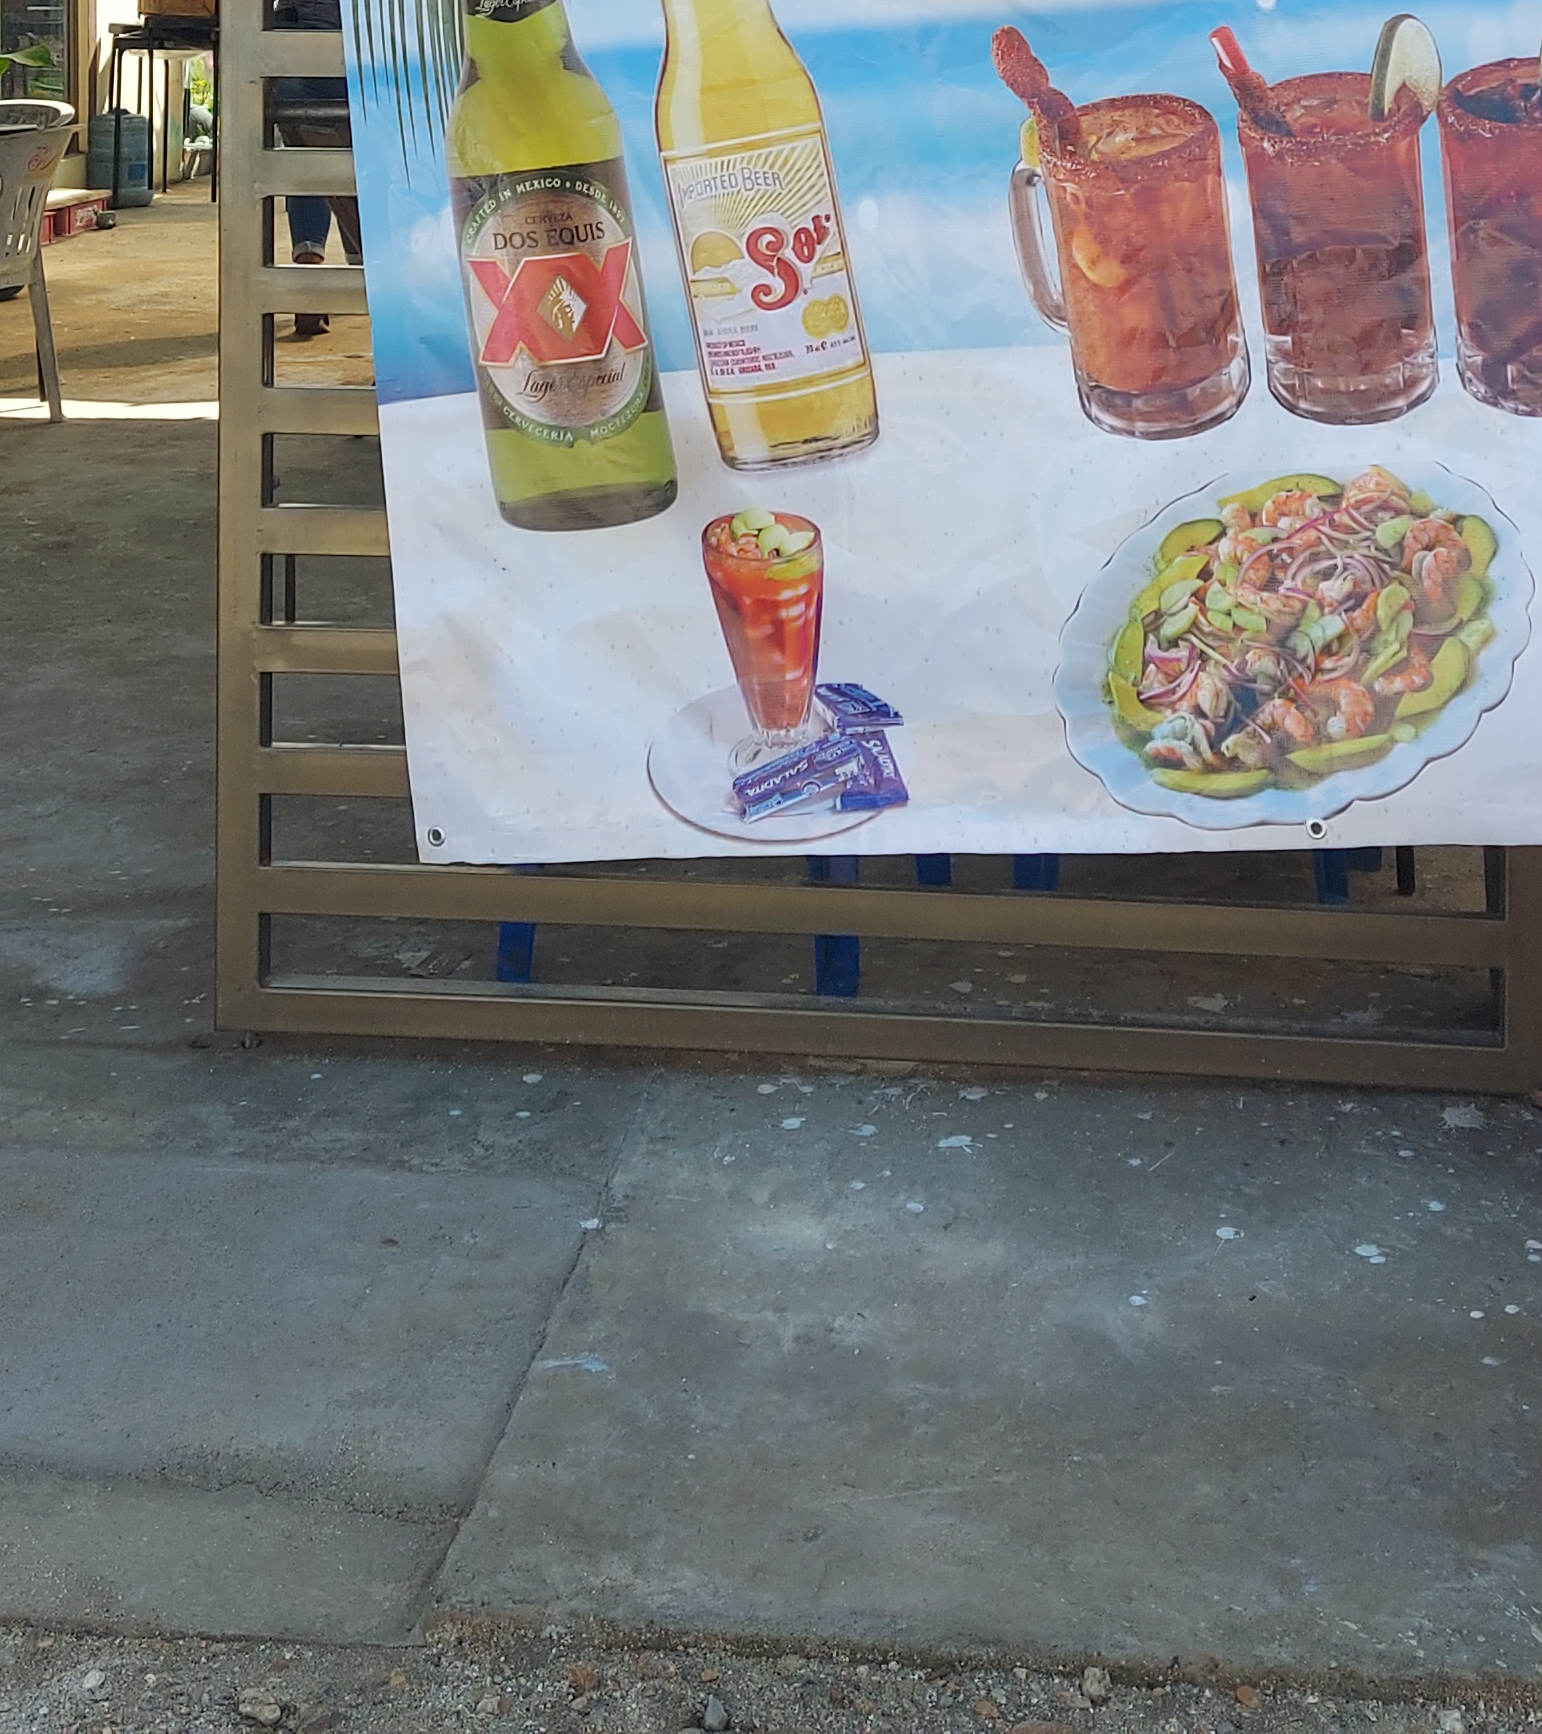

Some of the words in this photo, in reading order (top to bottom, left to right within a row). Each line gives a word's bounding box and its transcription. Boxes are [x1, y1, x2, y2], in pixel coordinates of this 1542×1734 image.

[466, 198, 497, 244] CRAFTED
[498, 188, 512, 202] IN
[515, 177, 561, 195] MEXICO
[575, 180, 608, 204] DESDE
[492, 231, 539, 251] DOS
[544, 220, 606, 248] EQUIS
[465, 237, 649, 368] XX
